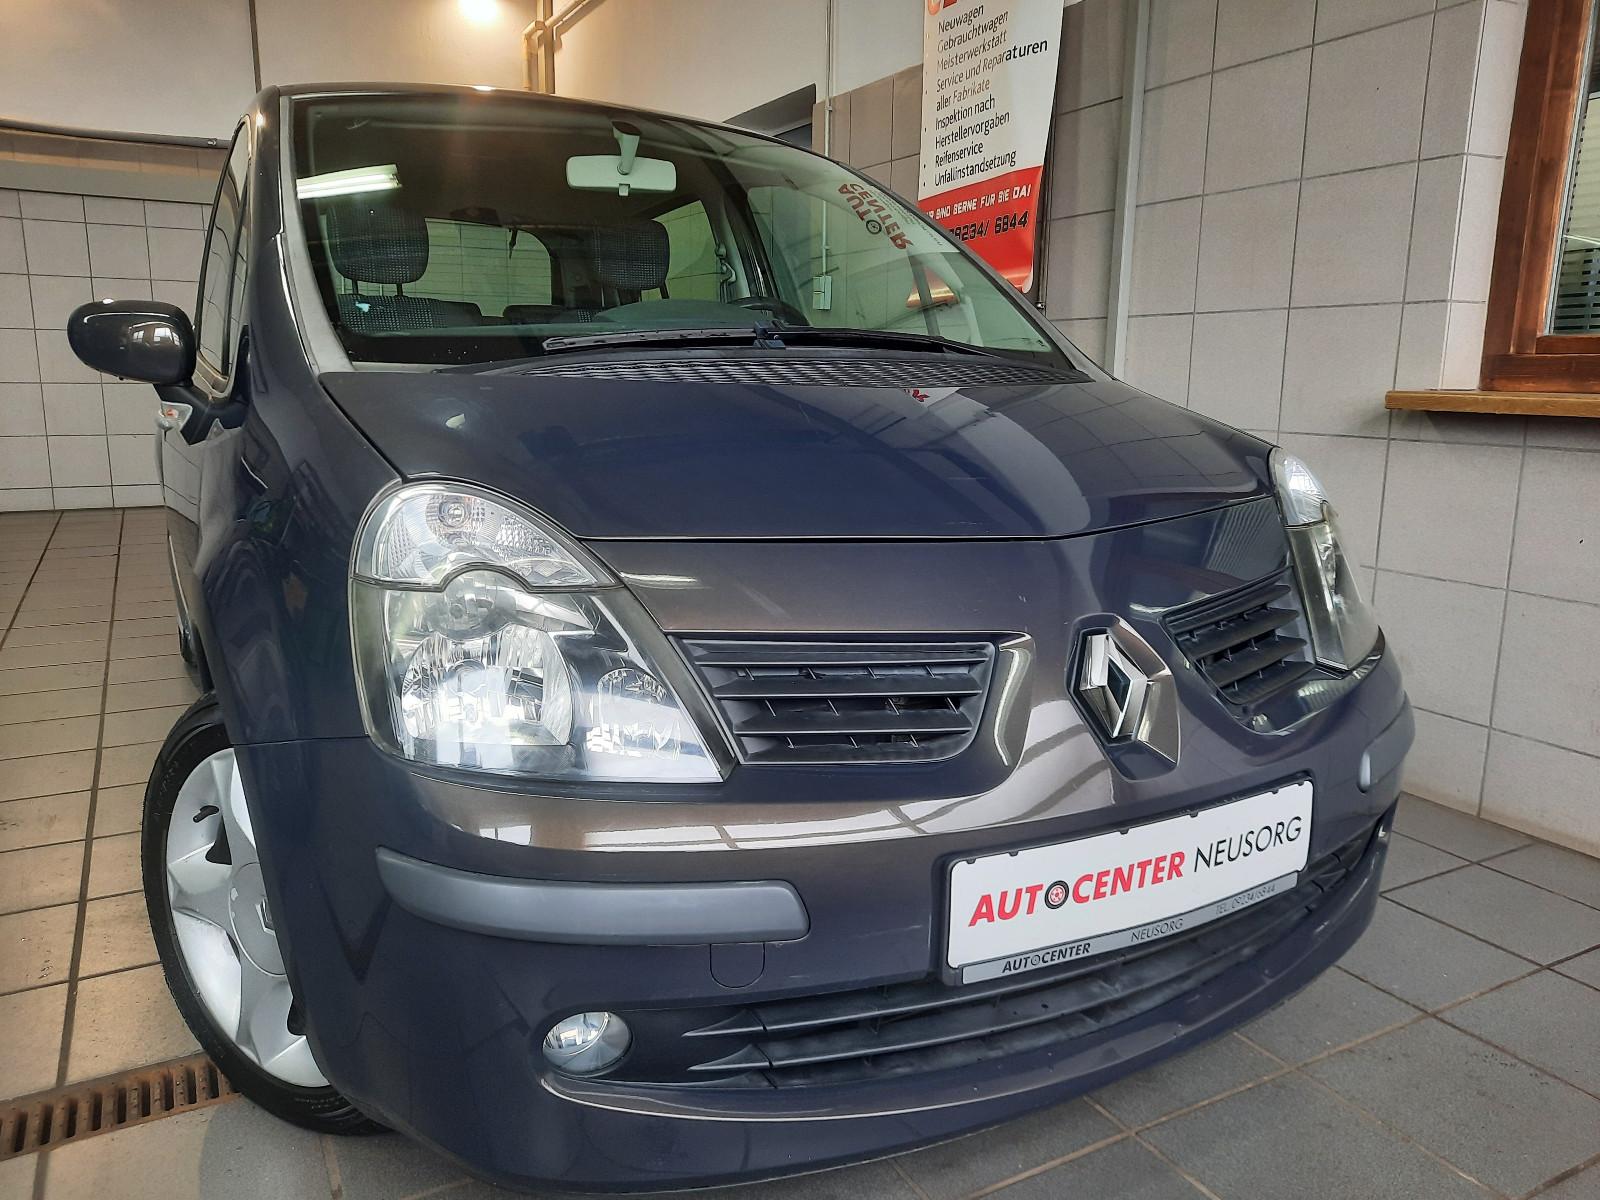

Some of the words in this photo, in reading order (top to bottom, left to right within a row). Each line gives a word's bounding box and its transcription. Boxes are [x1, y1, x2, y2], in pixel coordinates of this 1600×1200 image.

[938, 5, 984, 34] Neuwagen
[938, 11, 1009, 53] Gebrauchtwagen
[937, 30, 1007, 73] Meisterwerkstatt
[937, 71, 964, 93] Service
[965, 58, 981, 80] und
[983, 40, 1048, 72] Reparaturen
[936, 95, 951, 112] aller
[953, 78, 990, 104] Fabrikate
[936, 106, 973, 131] Inspektion
[974, 93, 996, 115] nach
[935, 111, 1010, 149] Herstellervorgaben
[935, 141, 984, 168] Reifenservice
[935, 150, 1017, 187] Unfallinstandsetzung
[994, 211, 1029, 235] 6844
[1194, 816, 1302, 872] NEUSORG
[1131, 917, 1183, 943] NEUSORG
